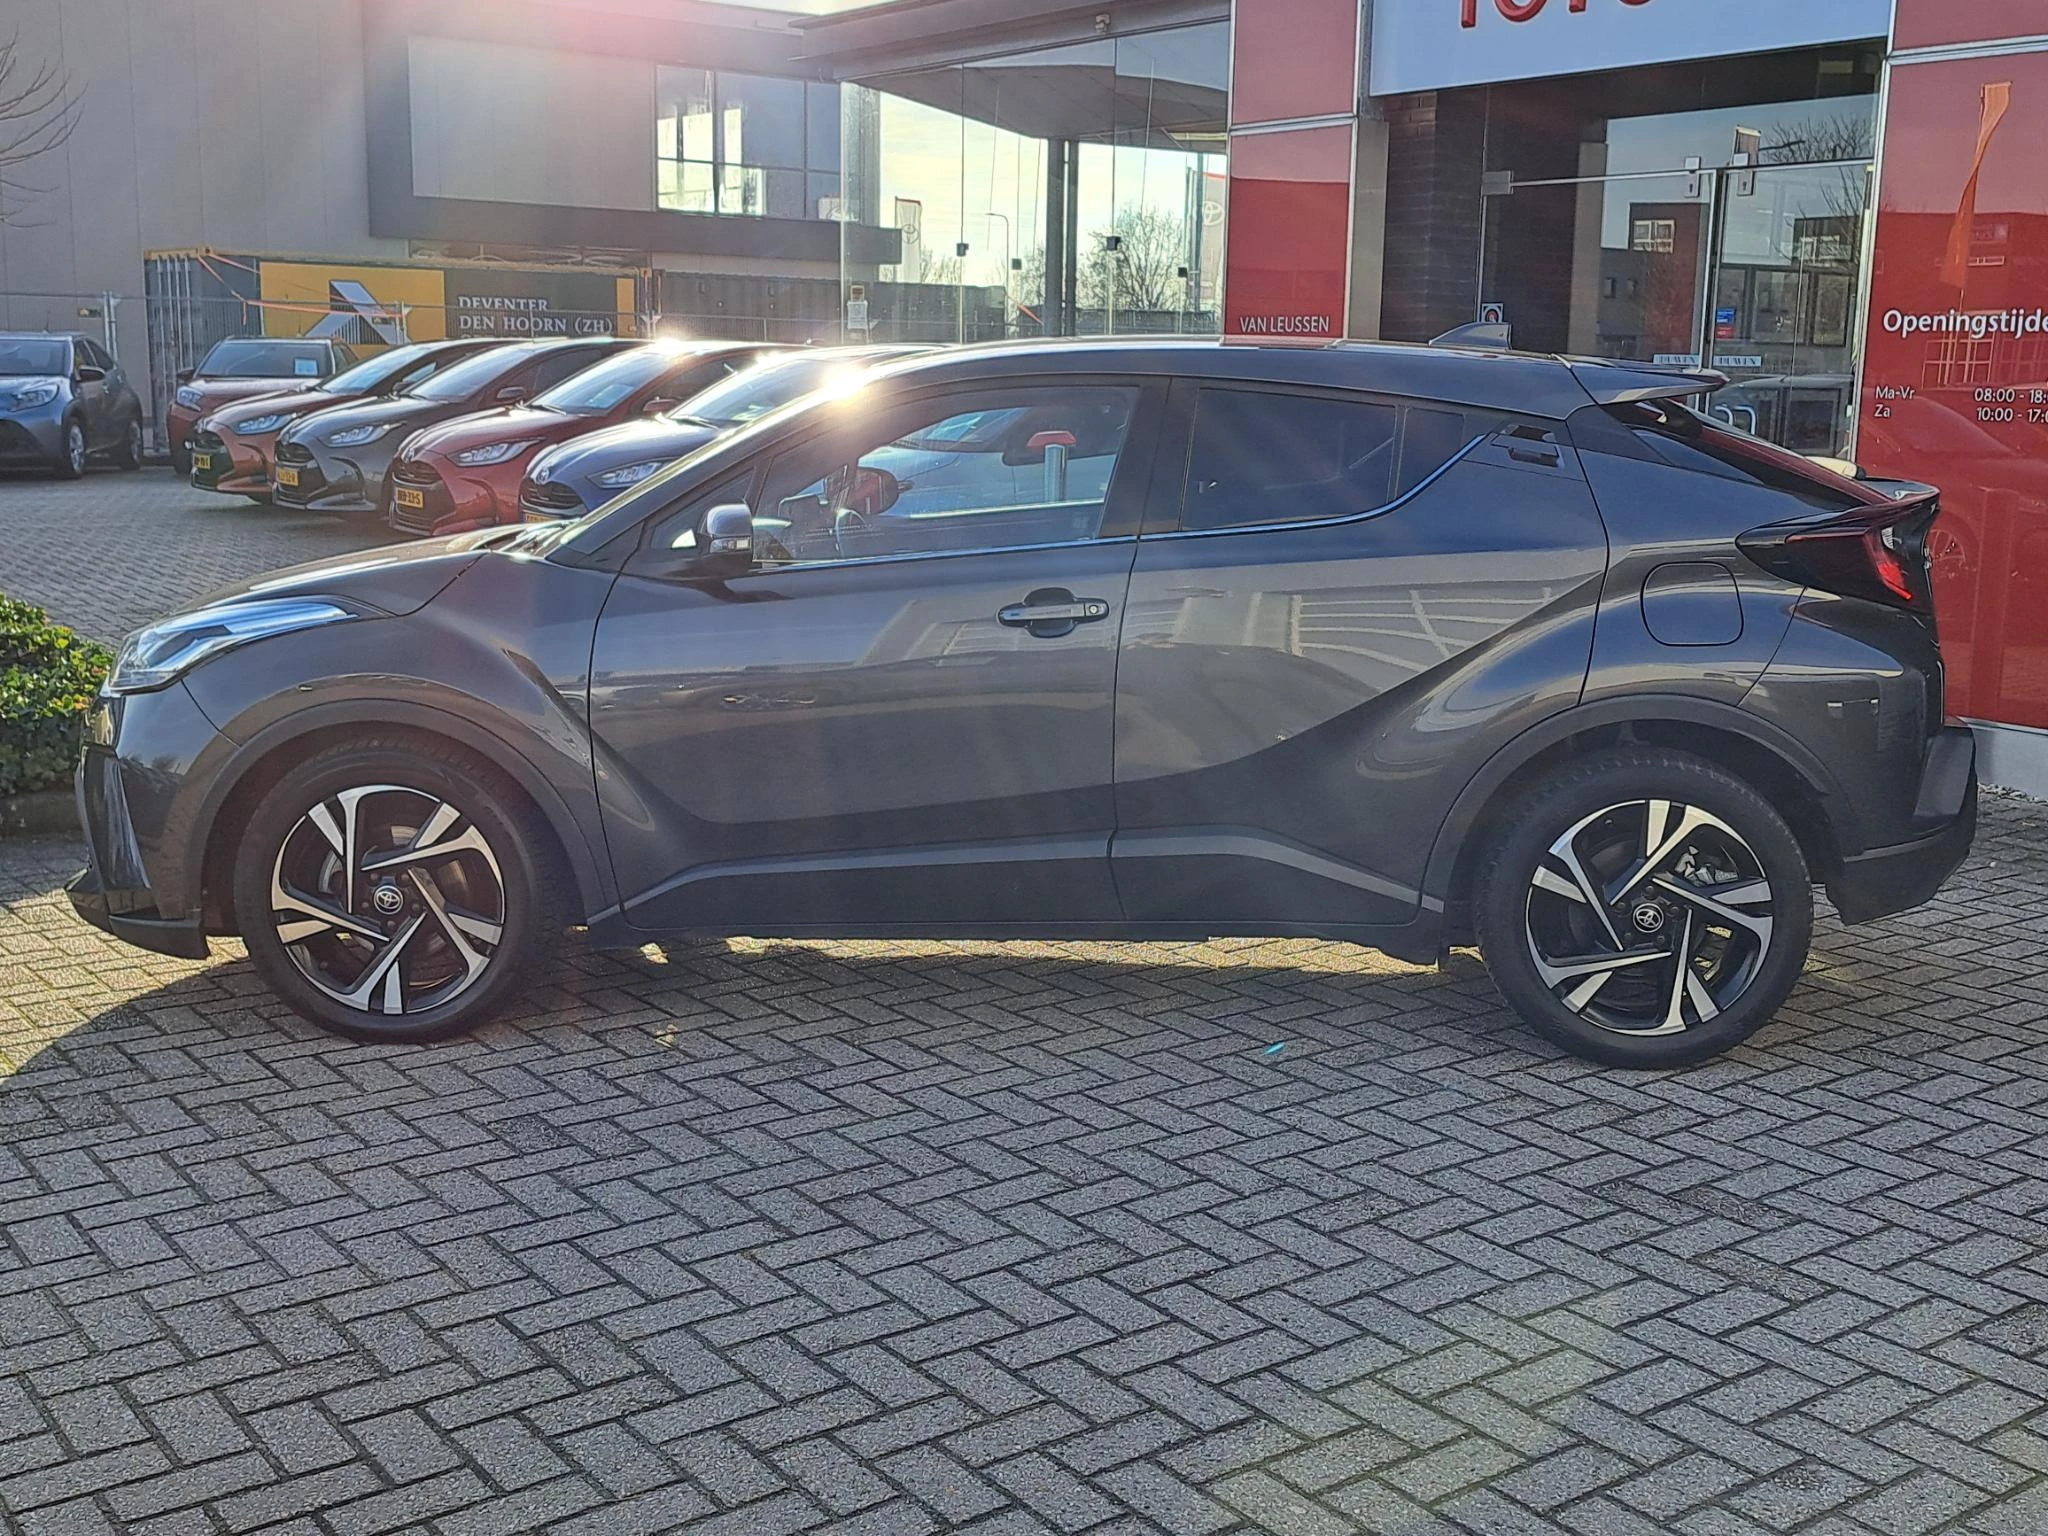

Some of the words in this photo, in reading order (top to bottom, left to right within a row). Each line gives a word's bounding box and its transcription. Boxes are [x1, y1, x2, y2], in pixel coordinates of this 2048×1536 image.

[458, 296, 549, 311] DEVENTER
[459, 315, 495, 330] DEN
[503, 316, 567, 332] HOORN
[575, 317, 613, 335] (ZH)
[1240, 316, 1266, 333] VAN
[1270, 316, 1330, 333] LEUSSEN
[1875, 385, 1915, 400] Ma-Vr
[1974, 387, 2015, 403] 08:00
[2030, 389, 2048, 404] 18:
[1874, 404, 1891, 418] Za
[1976, 407, 2014, 422] 10:00
